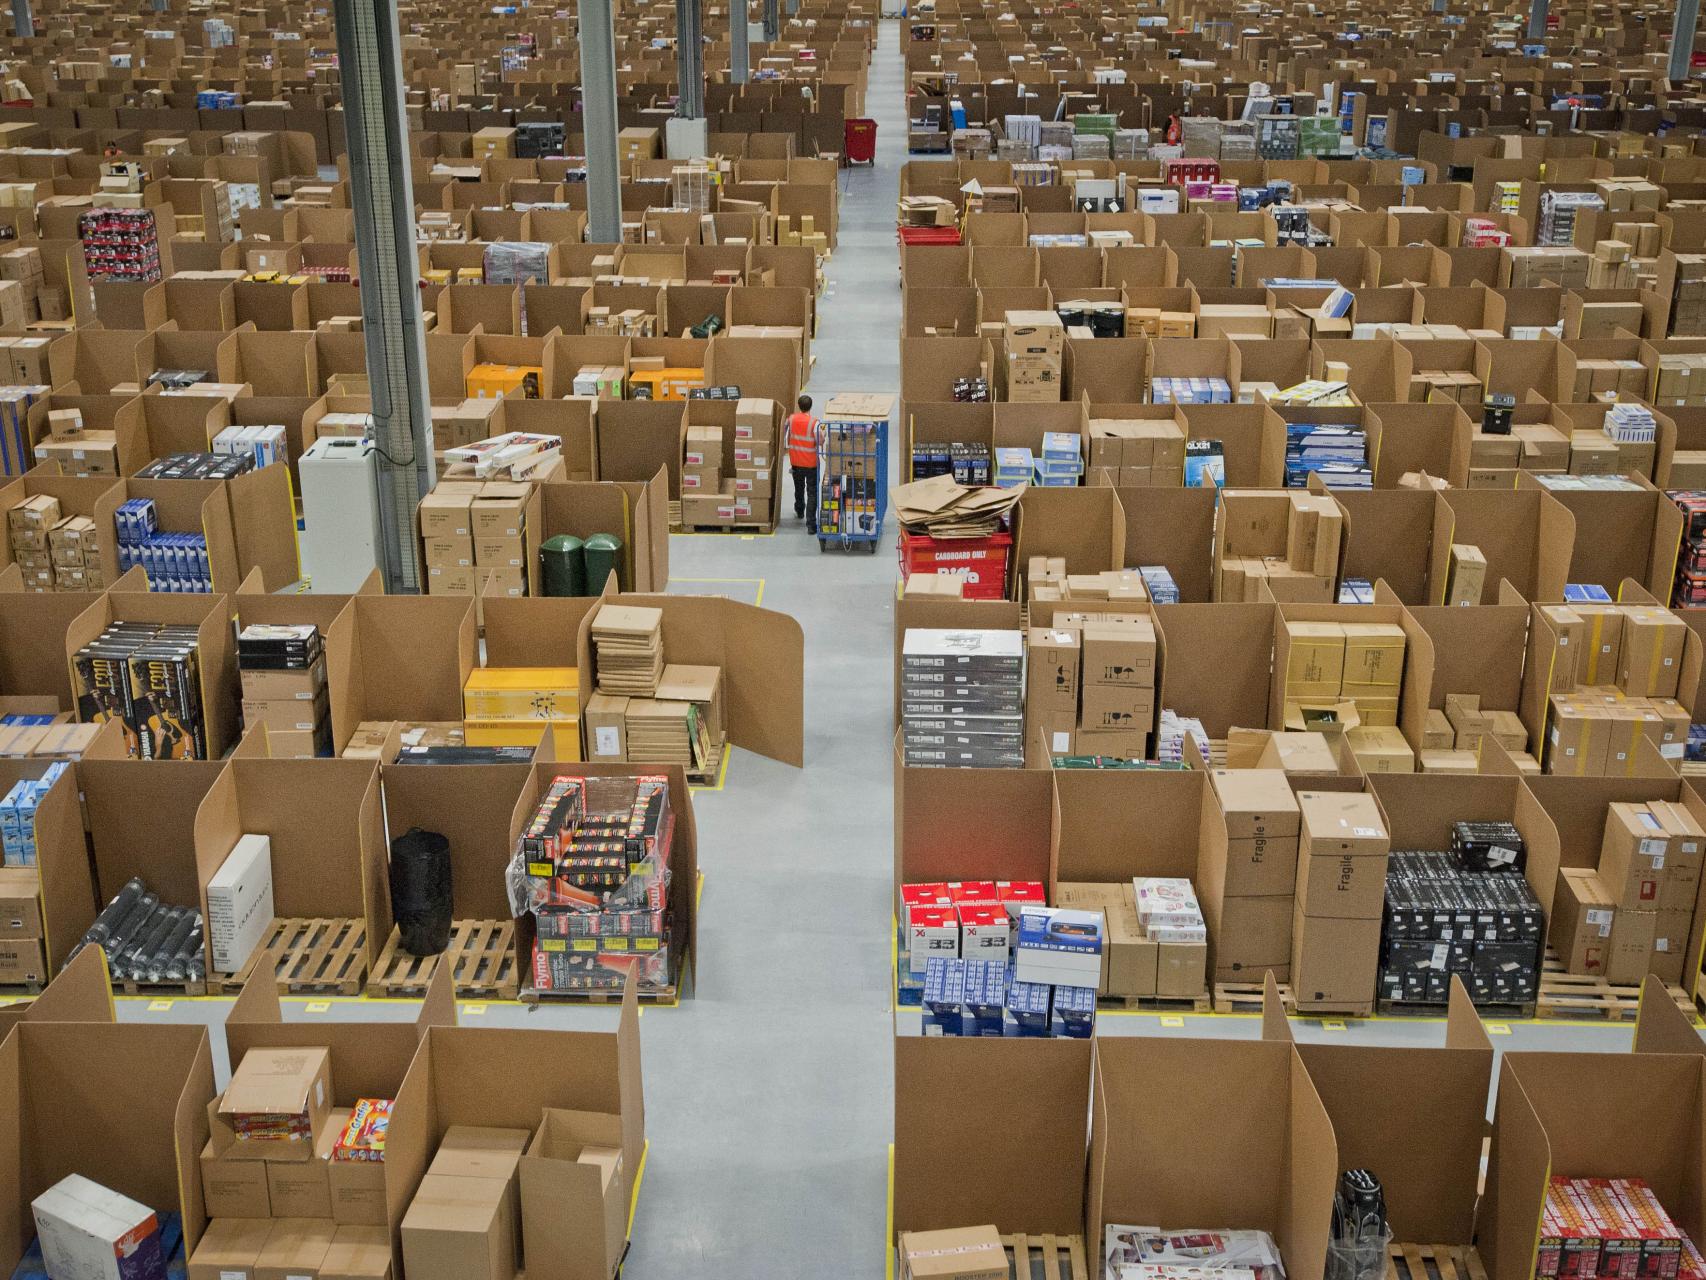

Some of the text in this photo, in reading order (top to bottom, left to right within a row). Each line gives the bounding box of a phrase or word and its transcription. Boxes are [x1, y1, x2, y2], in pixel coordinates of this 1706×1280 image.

[935, 550, 986, 560] CARDBOARD ONLY
[148, 661, 169, 691] F310
[140, 731, 153, 759] YAMAHA
[640, 774, 667, 783] Flymo
[1251, 826, 1267, 864] Fragile
[1337, 854, 1354, 892] Fragile
[536, 953, 549, 989] Flymo
